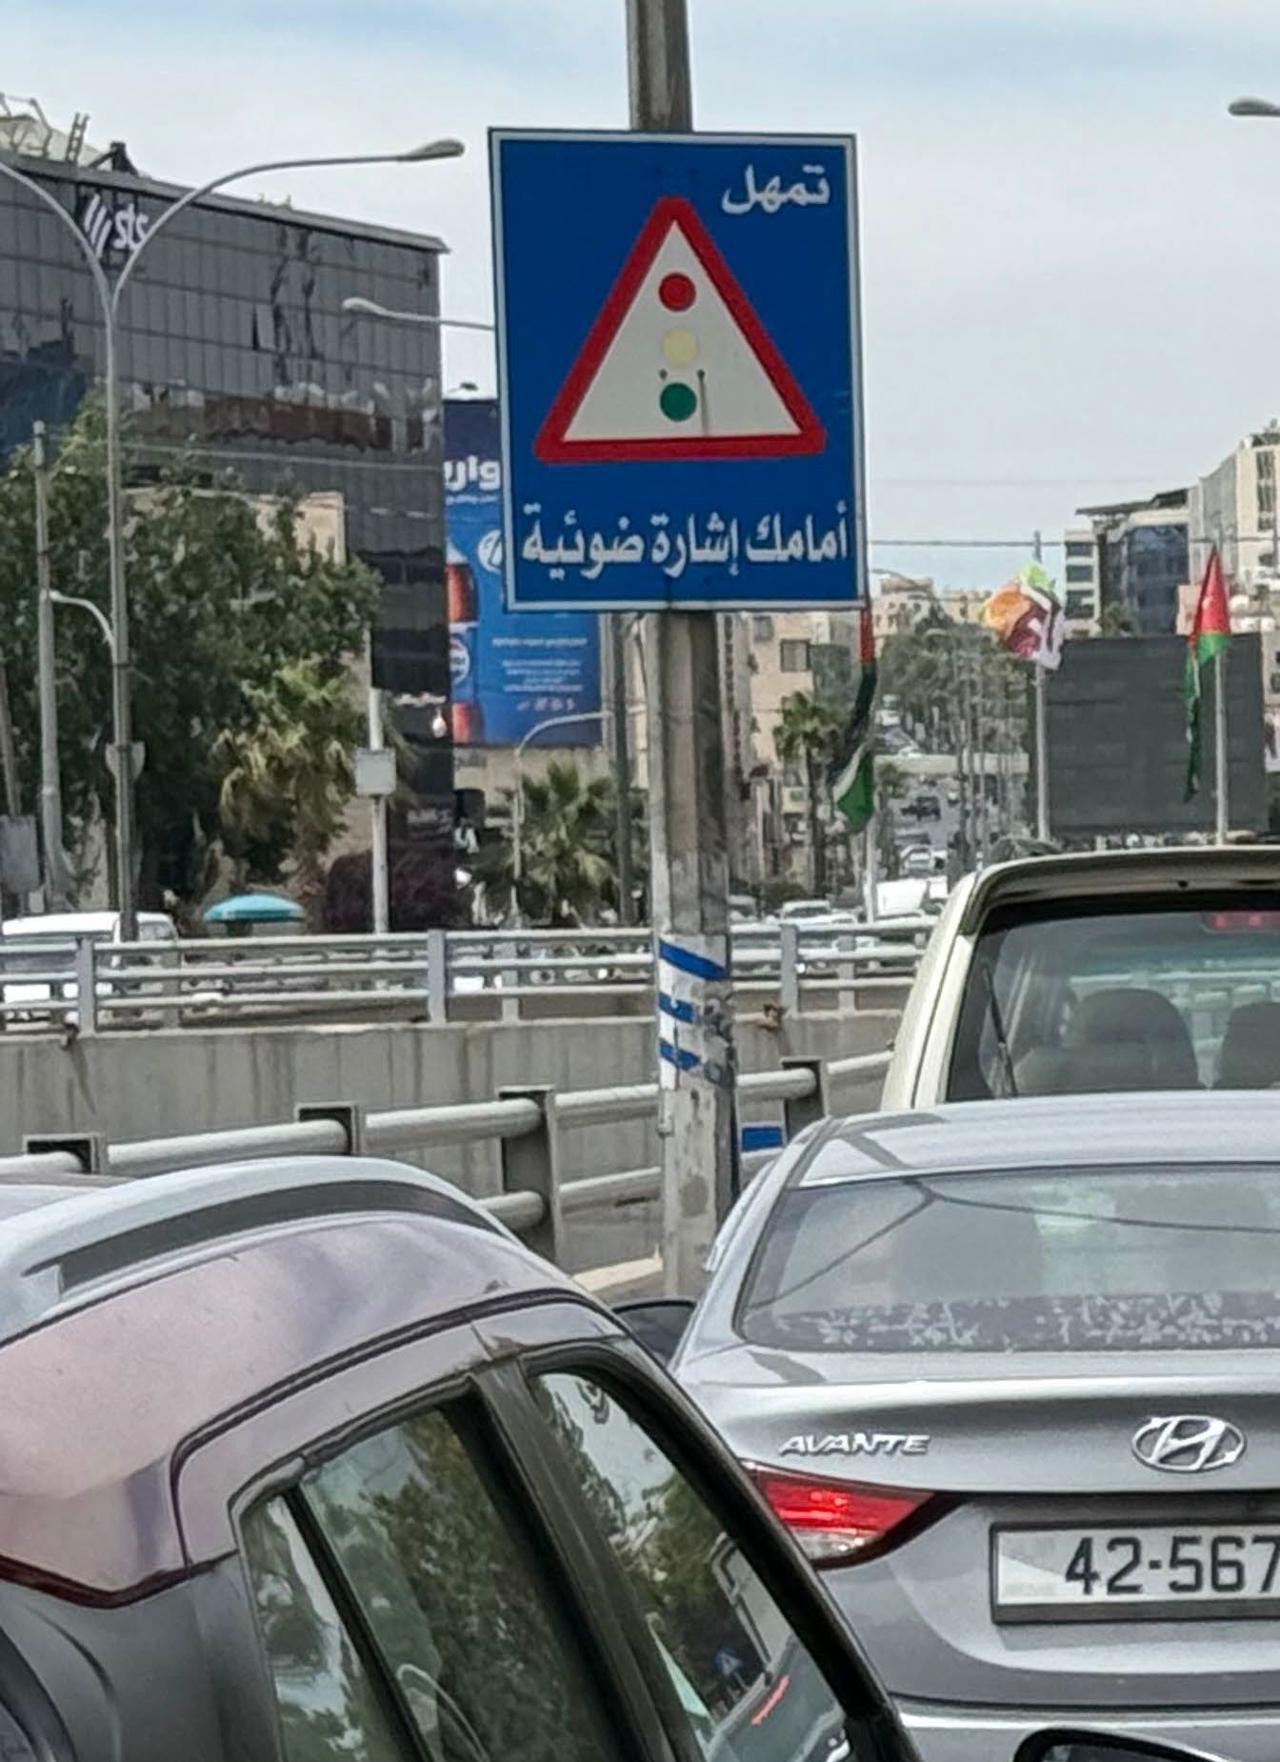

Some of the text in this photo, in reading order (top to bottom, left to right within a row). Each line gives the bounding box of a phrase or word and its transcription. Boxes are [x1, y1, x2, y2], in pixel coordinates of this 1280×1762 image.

[721, 164, 831, 214] تمهل
[522, 500, 848, 580] أمامك إشارة ضوئية
[779, 1432, 931, 1456] AVANTE
